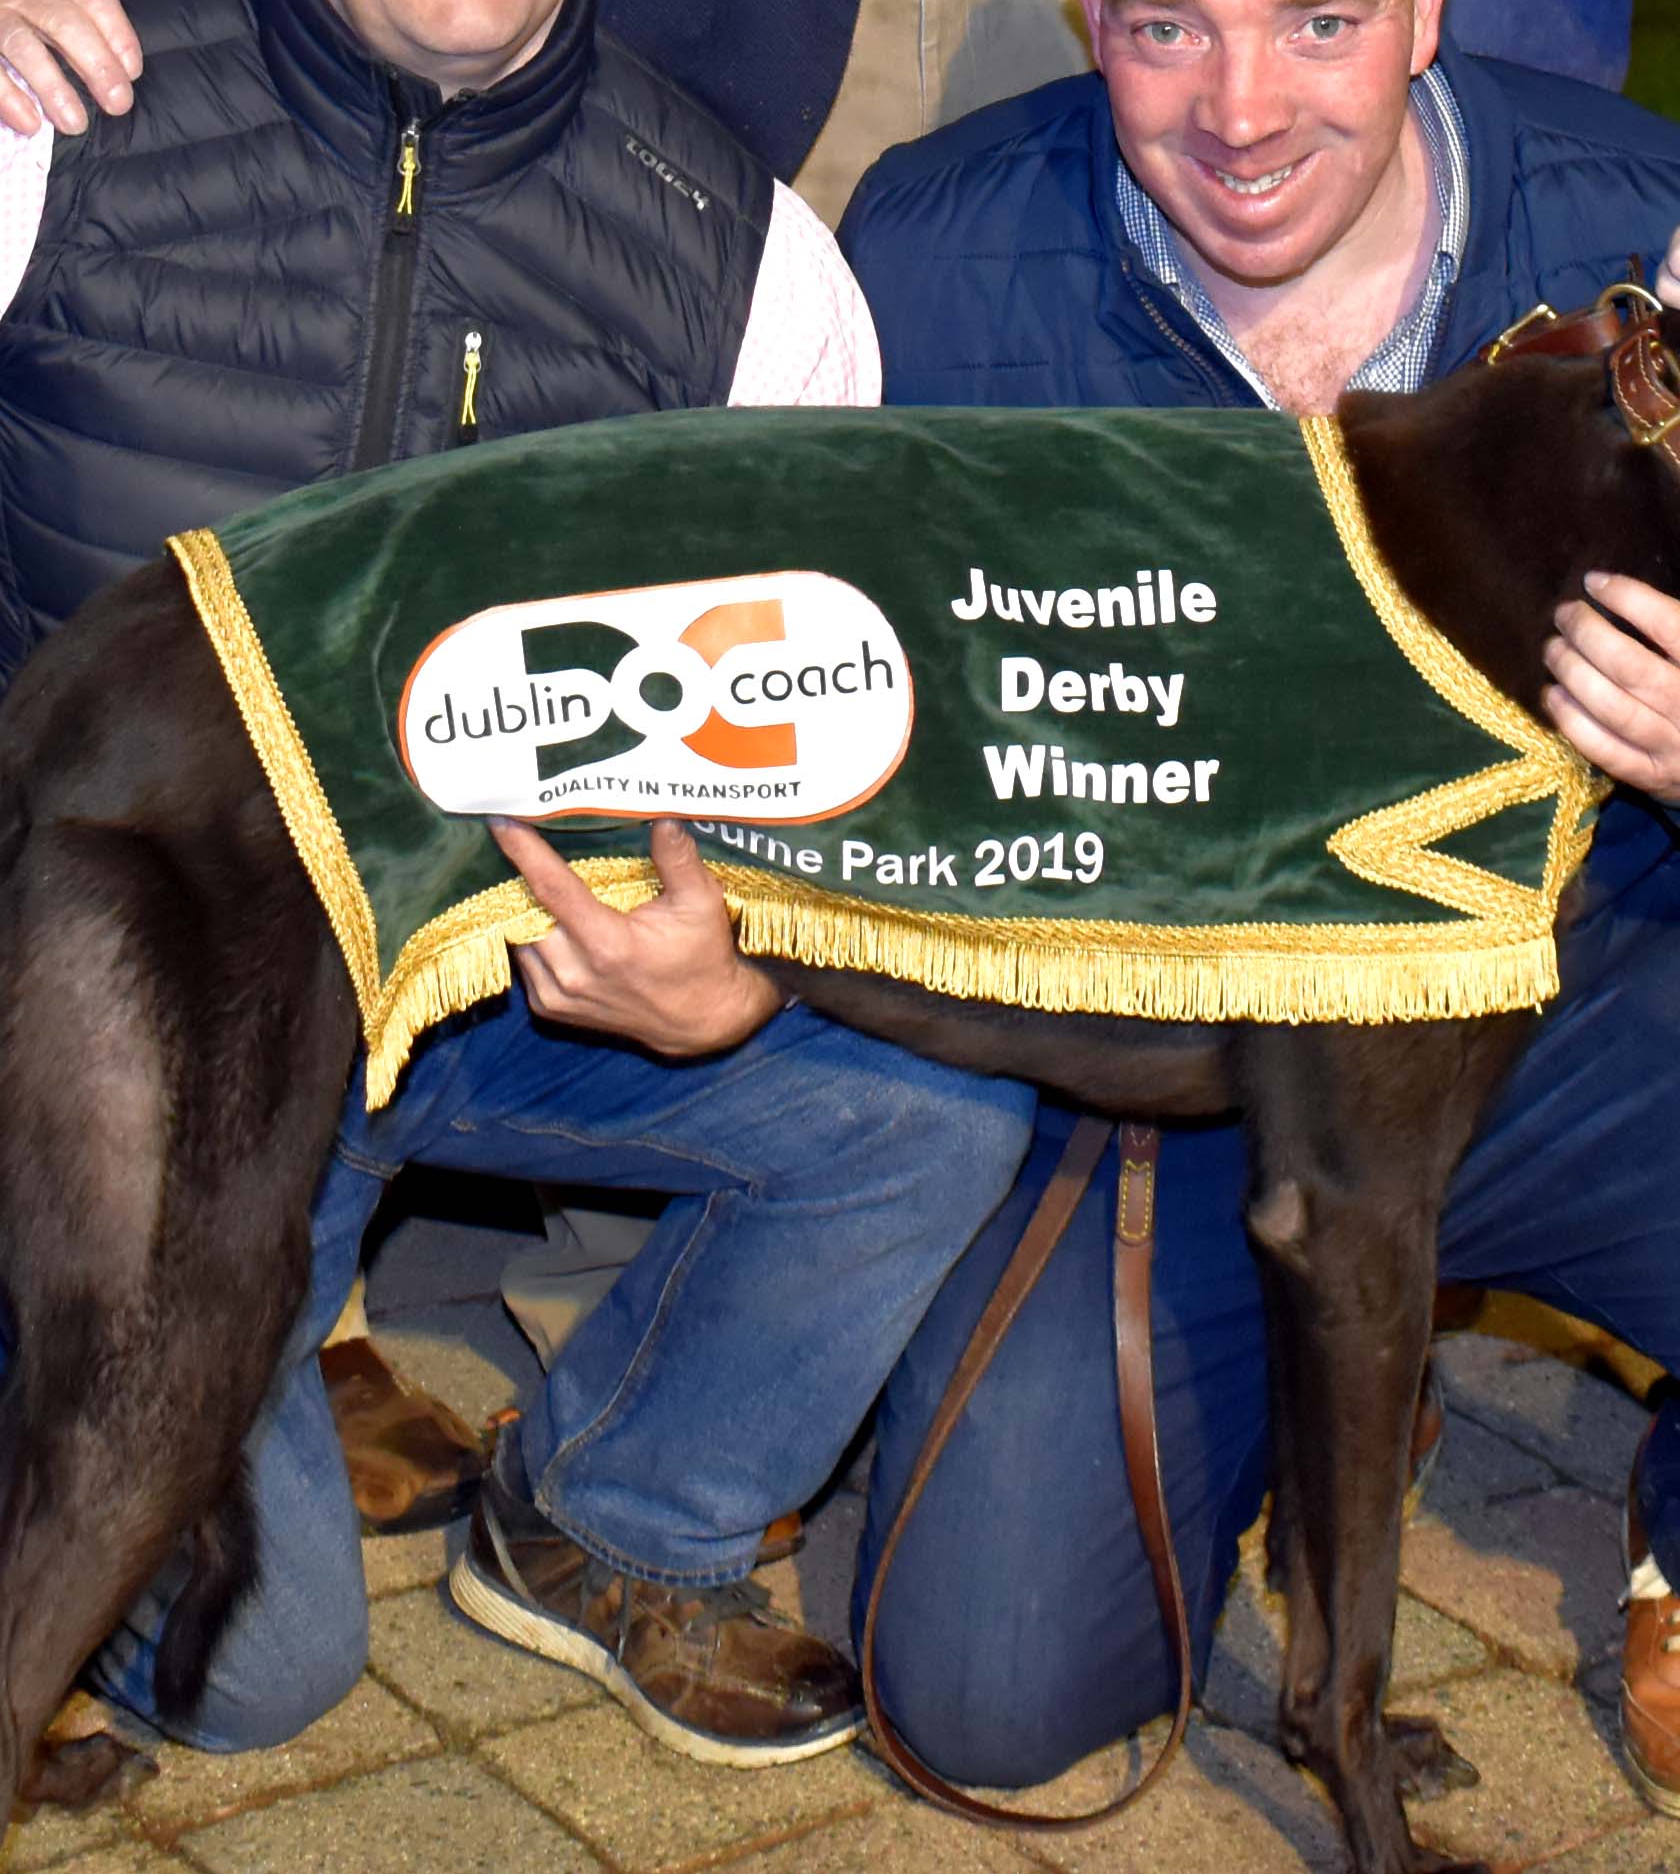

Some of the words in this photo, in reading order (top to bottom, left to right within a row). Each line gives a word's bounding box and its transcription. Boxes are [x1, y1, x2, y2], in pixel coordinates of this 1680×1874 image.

[950, 567, 1218, 628] Juvenile
[424, 685, 592, 744] dublin
[730, 640, 895, 705] coach
[1001, 656, 1185, 727] Derby
[538, 776, 630, 804] QUALITY
[638, 781, 660, 796] IN
[667, 781, 802, 800] TRANSPORT
[982, 744, 1220, 804] Winner
[841, 840, 958, 887] Park
[973, 831, 1105, 887] 2019
